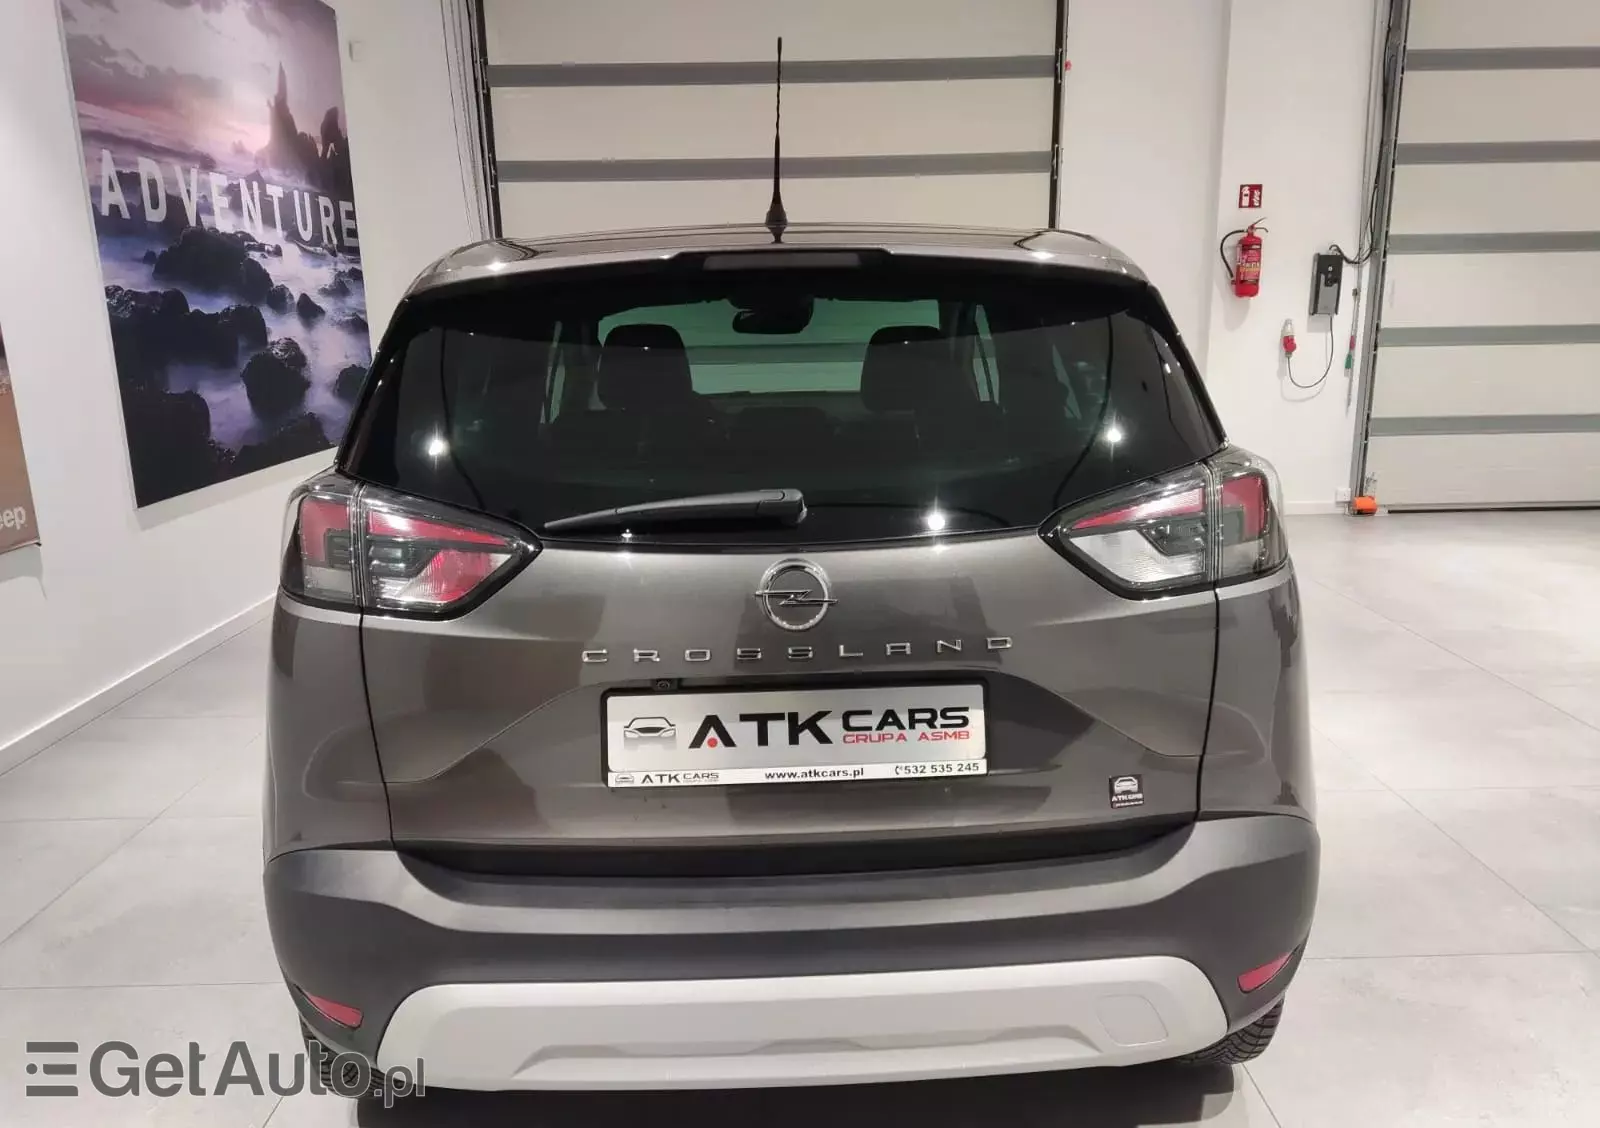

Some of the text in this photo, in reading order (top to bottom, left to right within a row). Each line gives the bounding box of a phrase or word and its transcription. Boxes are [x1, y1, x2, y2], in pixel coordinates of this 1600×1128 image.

[100, 147, 360, 248] ADVENTURE
[0, 506, 26, 530] ep
[581, 636, 1014, 663] CROSSLAND
[688, 706, 970, 749] ATK CARS
[842, 730, 971, 745] GRUPA ASMB
[640, 772, 720, 785] ATK CARS
[764, 762, 980, 780] www.atkcars.pl 532 535 245
